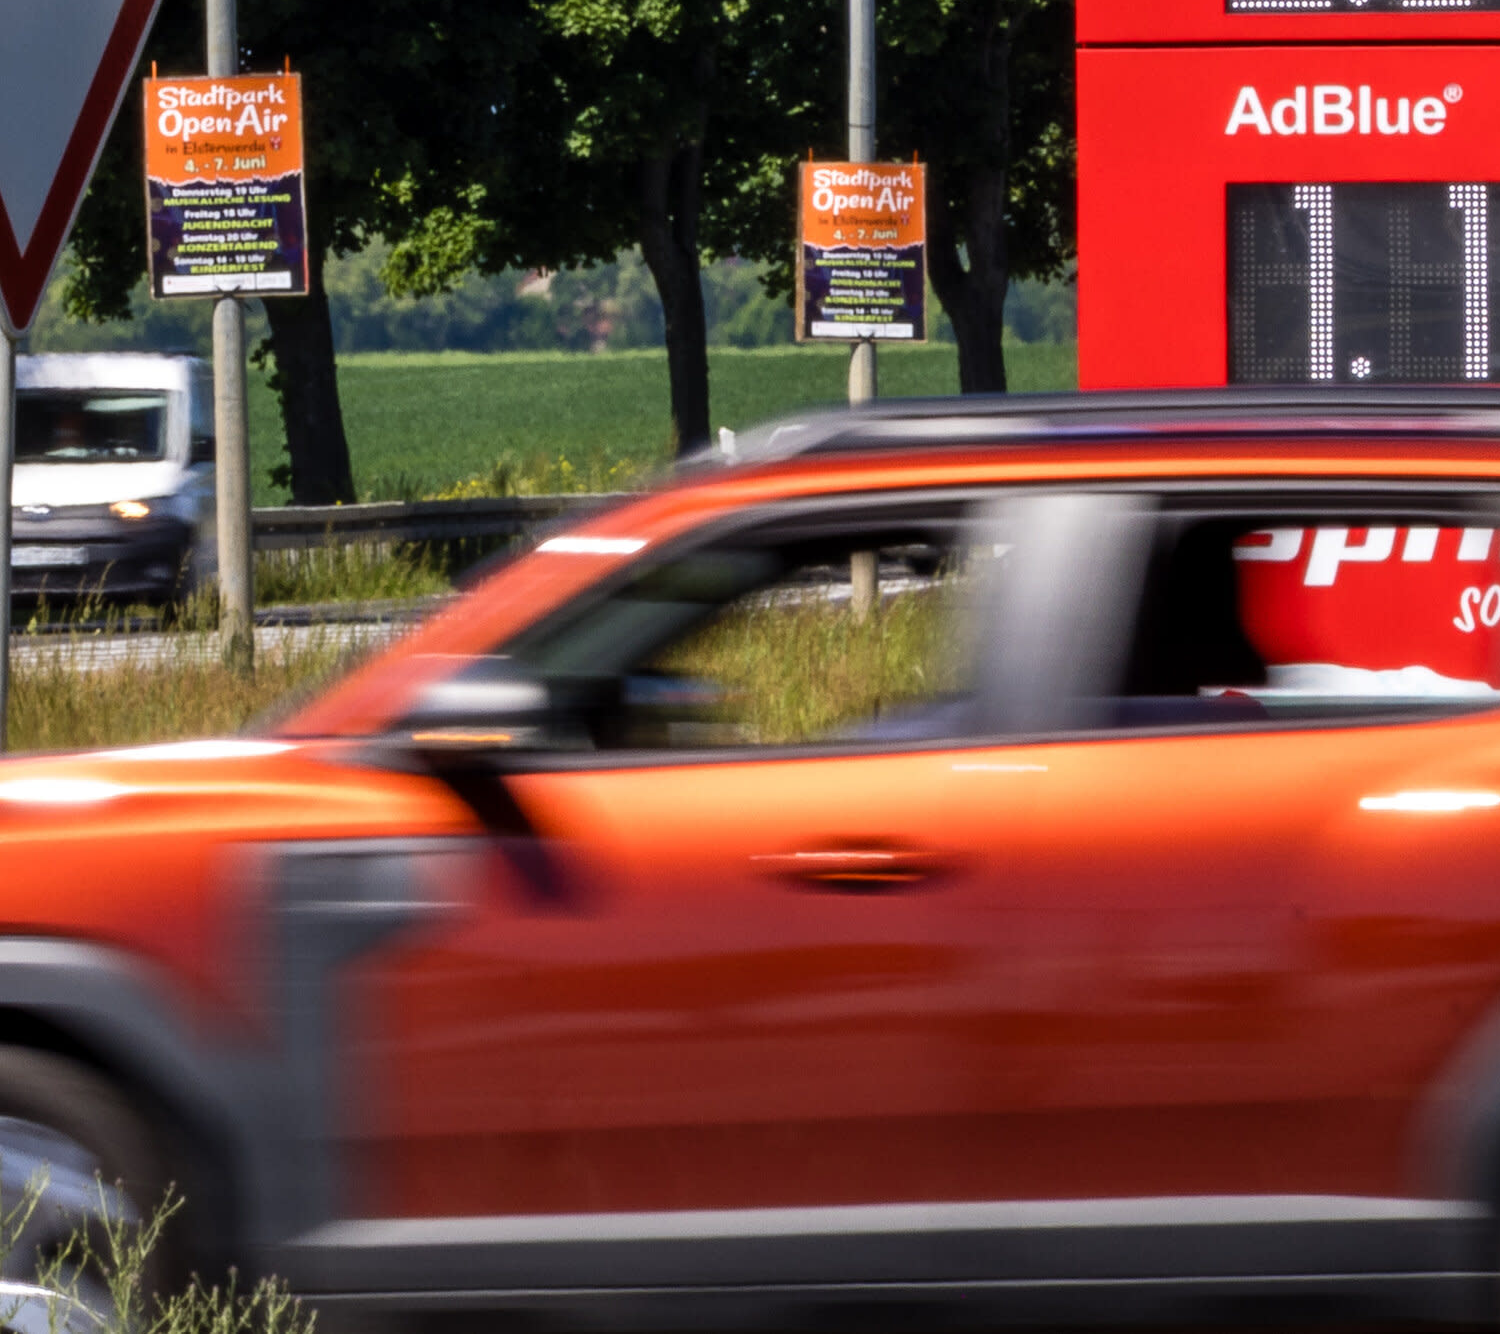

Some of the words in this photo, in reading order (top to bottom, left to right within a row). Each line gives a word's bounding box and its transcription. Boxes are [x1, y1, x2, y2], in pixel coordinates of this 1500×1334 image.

[158, 83, 286, 111] Stadtpark
[233, 155, 266, 171] Juni
[813, 169, 914, 190] Stadtpark
